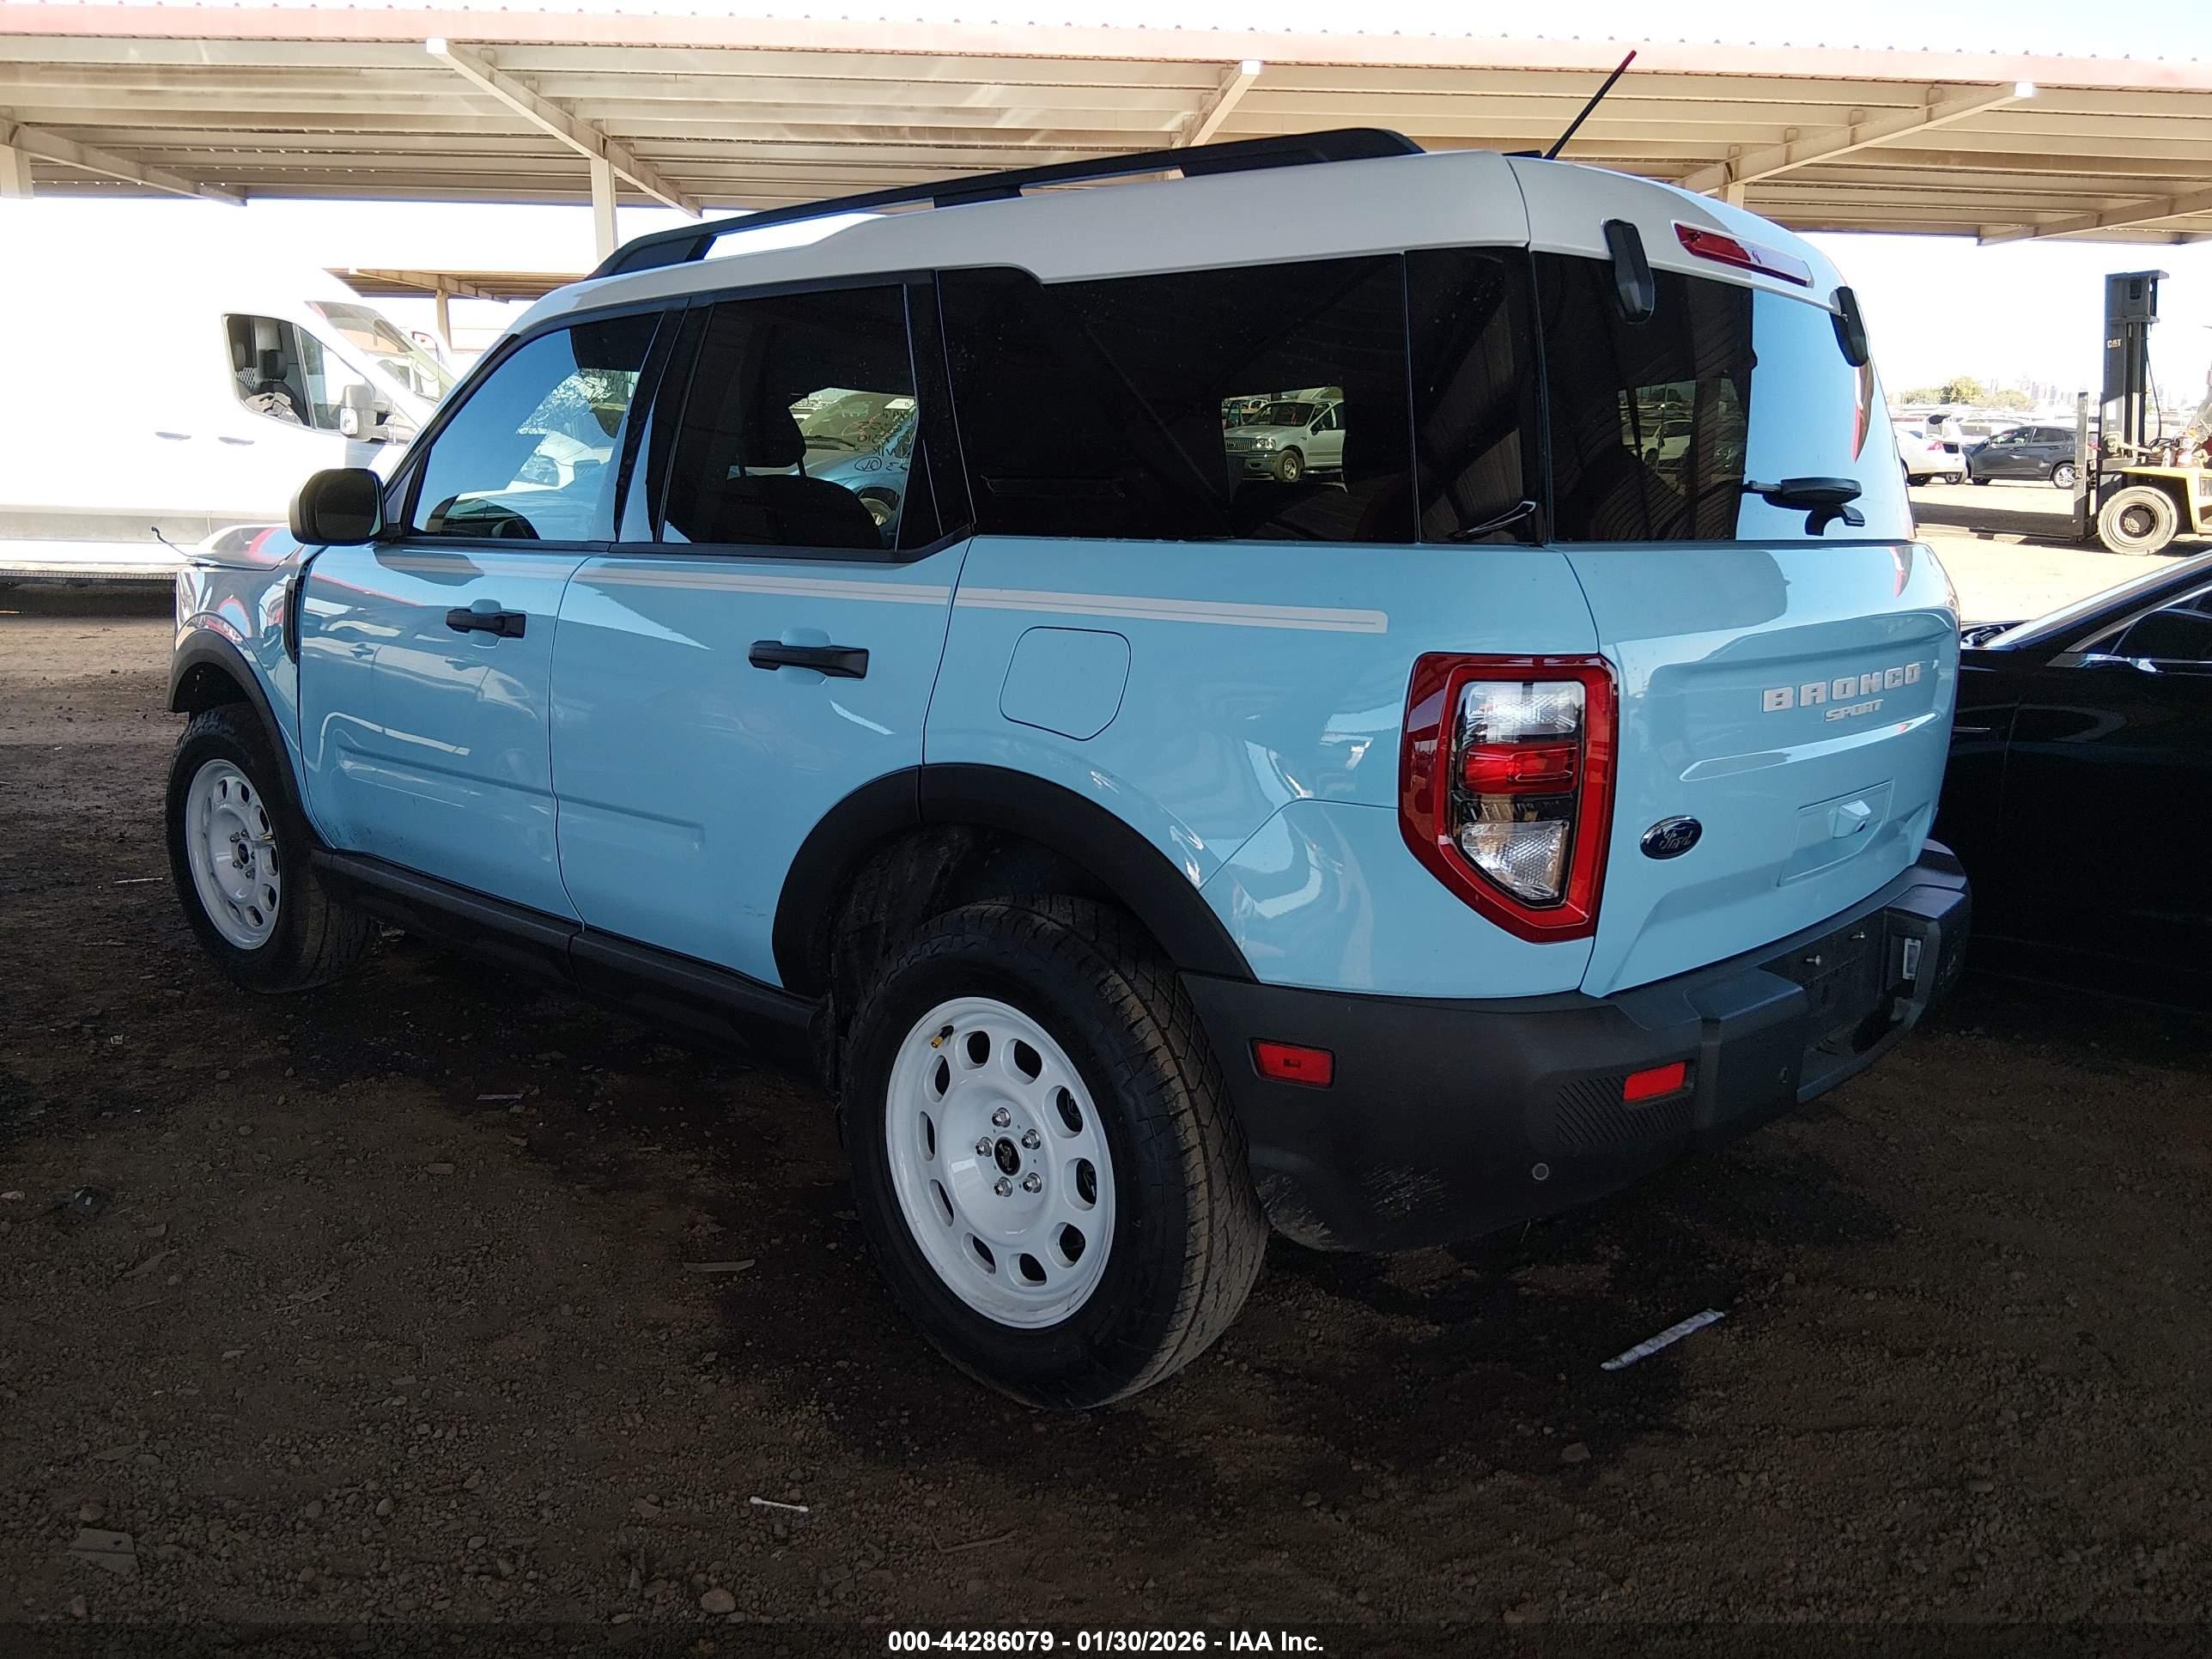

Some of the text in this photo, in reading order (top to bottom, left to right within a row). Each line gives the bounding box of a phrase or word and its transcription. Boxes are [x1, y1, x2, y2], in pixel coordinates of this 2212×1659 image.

[2106, 338, 2122, 349] CAT
[1762, 663, 1920, 713] BRONCO
[1824, 698, 1884, 722] SPORT
